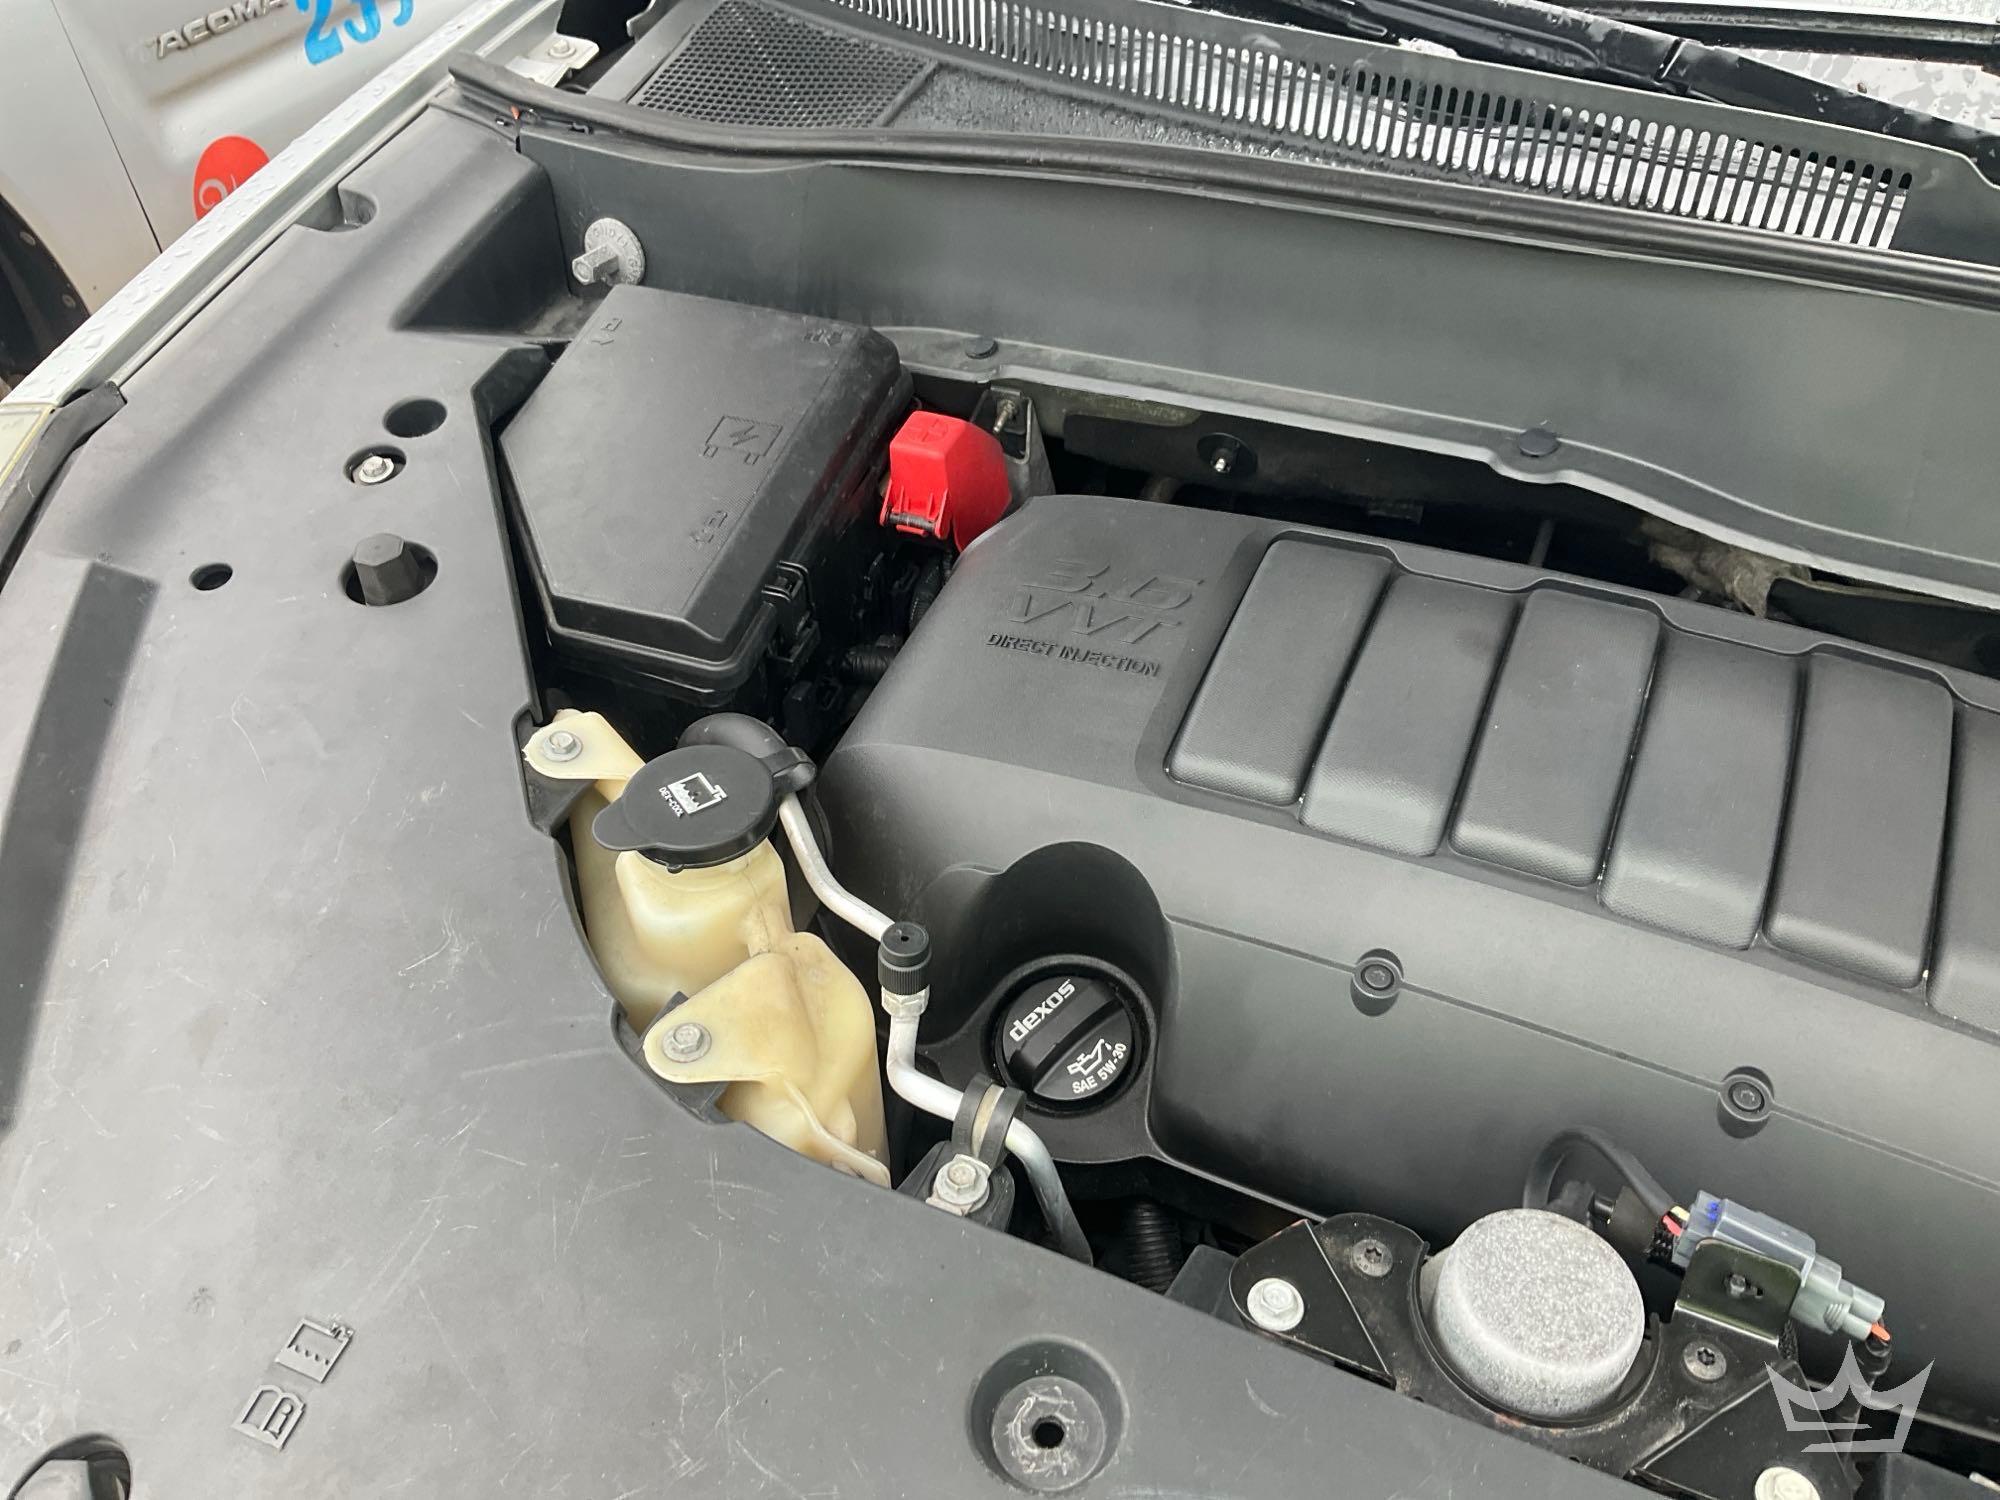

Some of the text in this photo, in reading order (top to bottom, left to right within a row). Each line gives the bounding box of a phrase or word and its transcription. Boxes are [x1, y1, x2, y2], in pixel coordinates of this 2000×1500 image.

[1007, 592, 1183, 644] VVT
[985, 633, 1162, 678] DIRECT INJECTION
[658, 785, 685, 819] DEX-COOL
[1009, 980, 1076, 1042] dexos
[1071, 1042, 1128, 1094] SAE 5W-30
